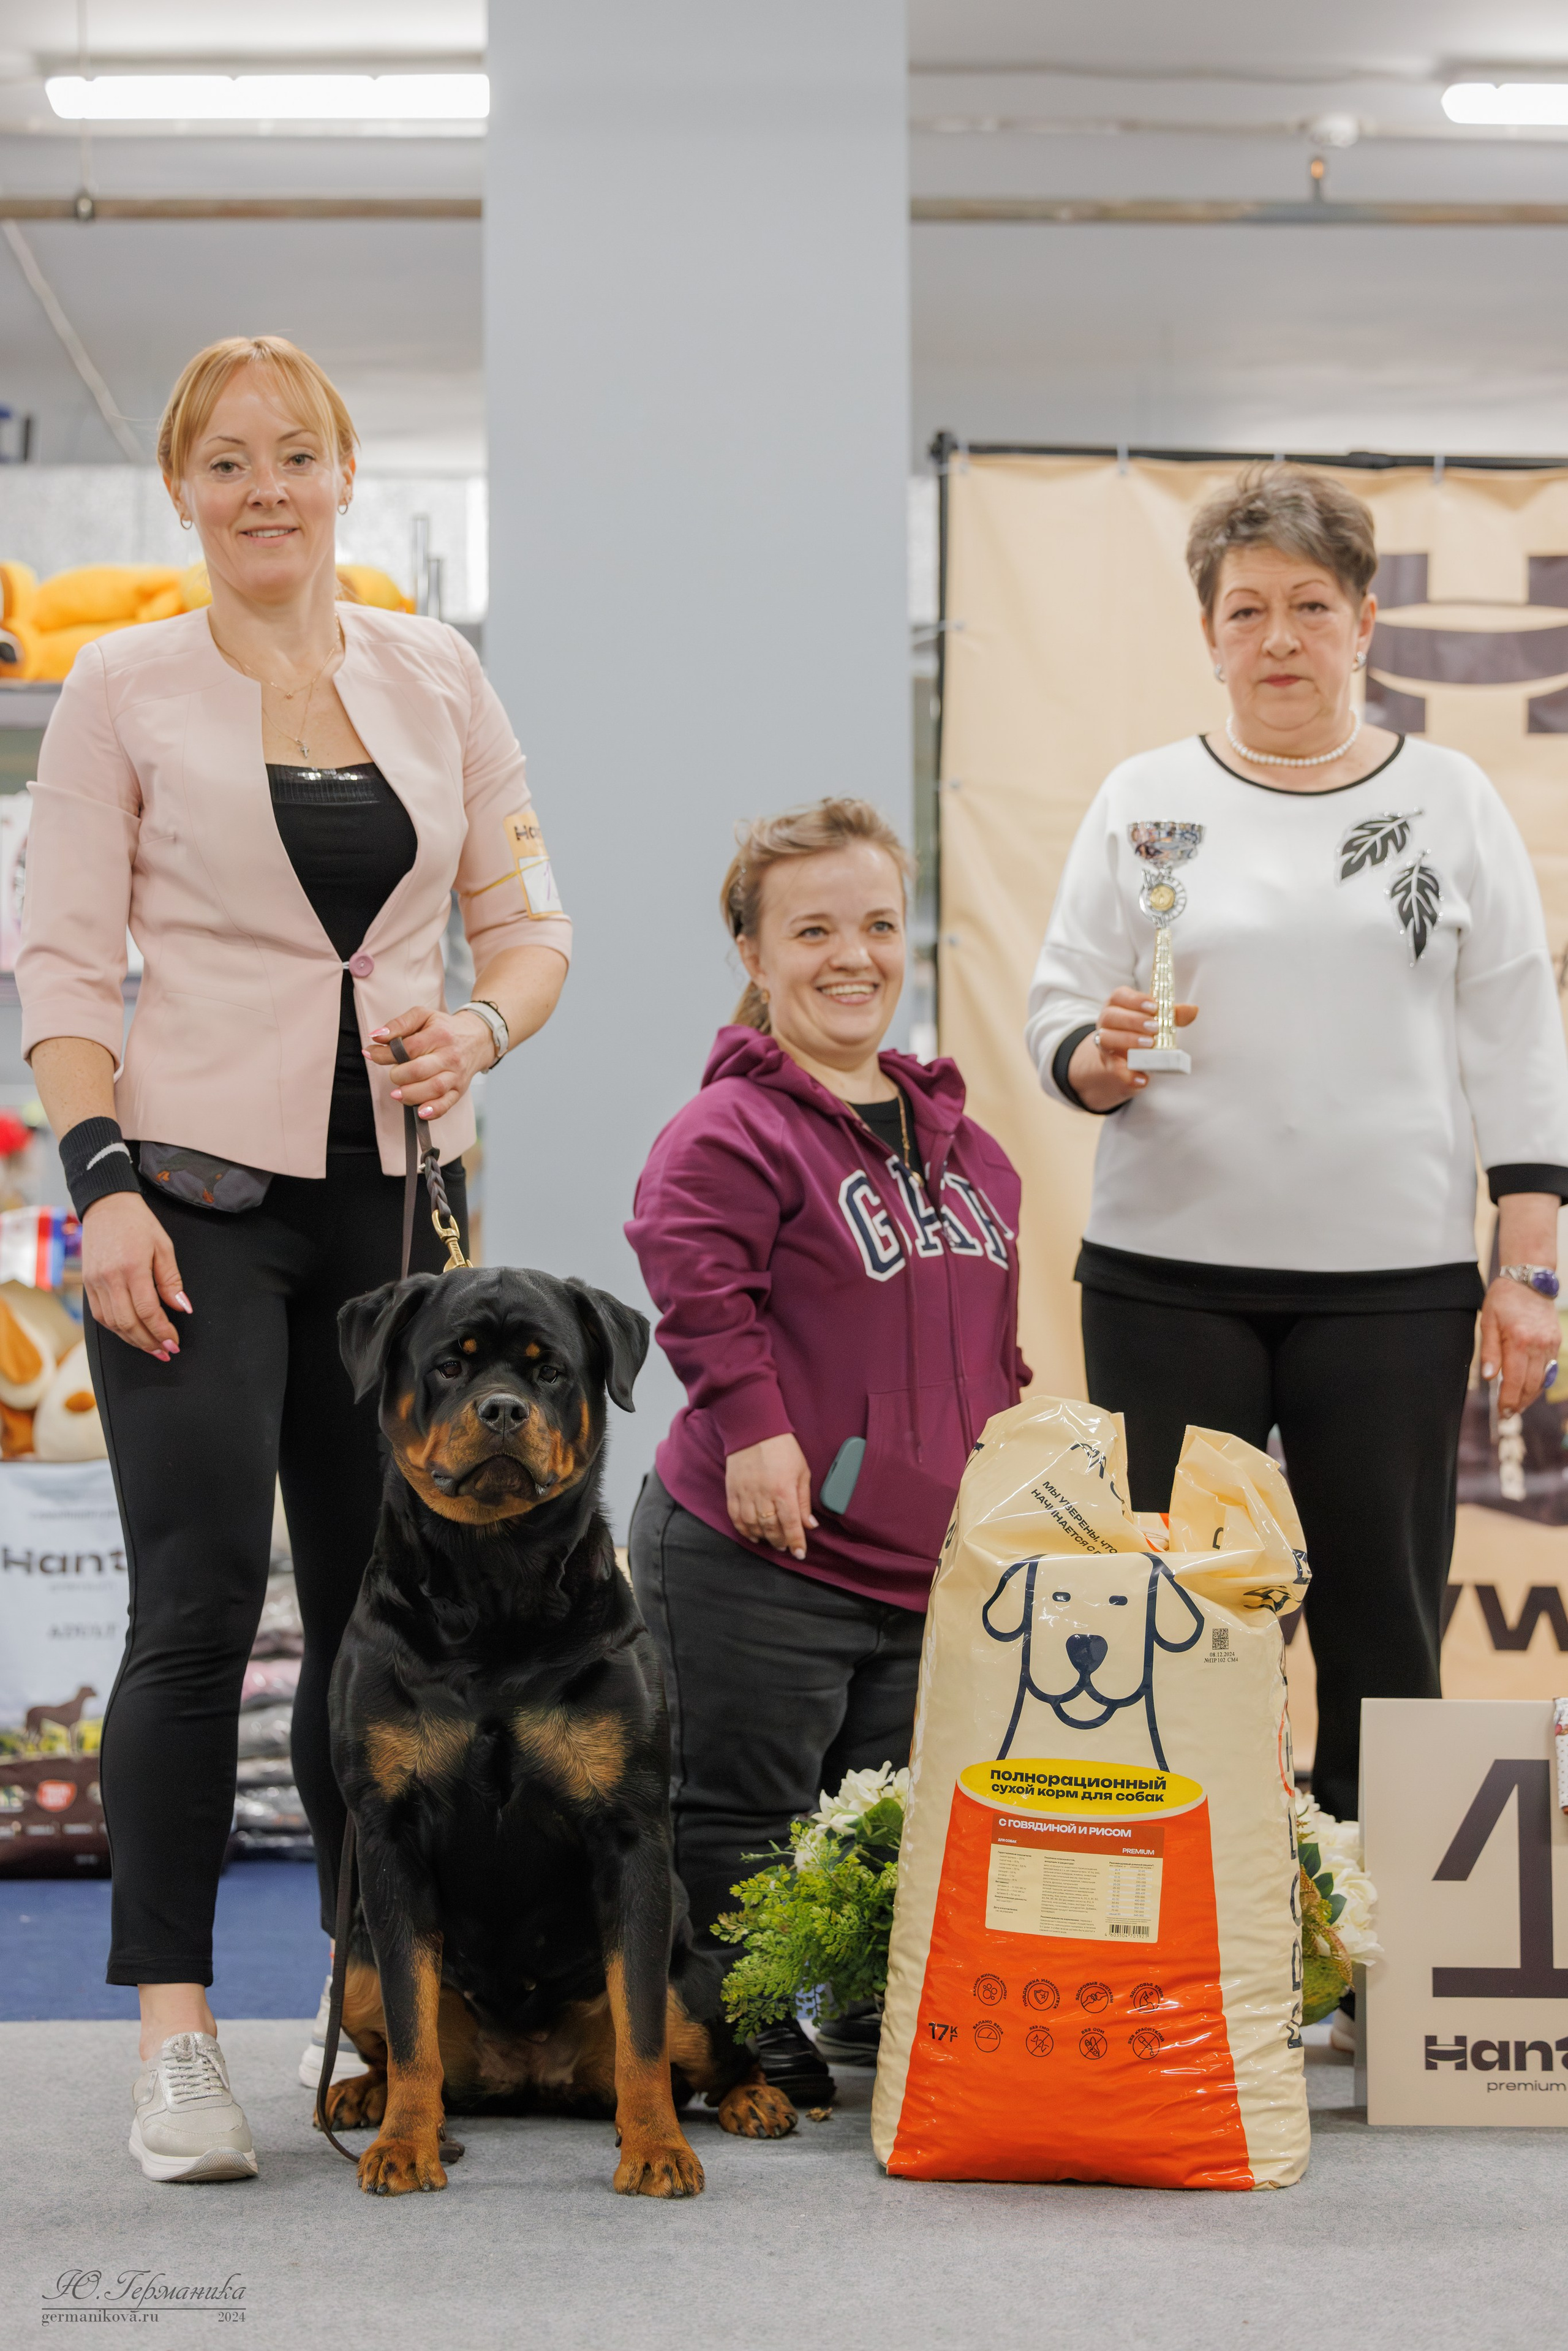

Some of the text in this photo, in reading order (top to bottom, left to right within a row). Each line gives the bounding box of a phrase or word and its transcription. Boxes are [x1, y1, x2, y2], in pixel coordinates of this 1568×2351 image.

[1031, 1489, 1089, 1547] НАЧИНАЕТСЯ
[1042, 1481, 1061, 1498] МЫ
[1101, 1540, 1118, 1553] ЧТО
[990, 1769, 1167, 1790] полнорационный
[992, 1783, 1164, 1803] сухой корм для собак
[998, 1818, 1132, 1838] С ГОВЯДИНОЙ И РИСОМ
[1022, 1978, 1060, 2009] ПОДДЕРЖКА ИММУНИТЕТА
[1076, 1981, 1098, 2001] ЗДОРОВЫЕ
[1129, 1982, 1154, 1998] ЗДОРОВЬЕ
[928, 2022, 949, 2041] 17
[1487, 2080, 1567, 2093] premium
